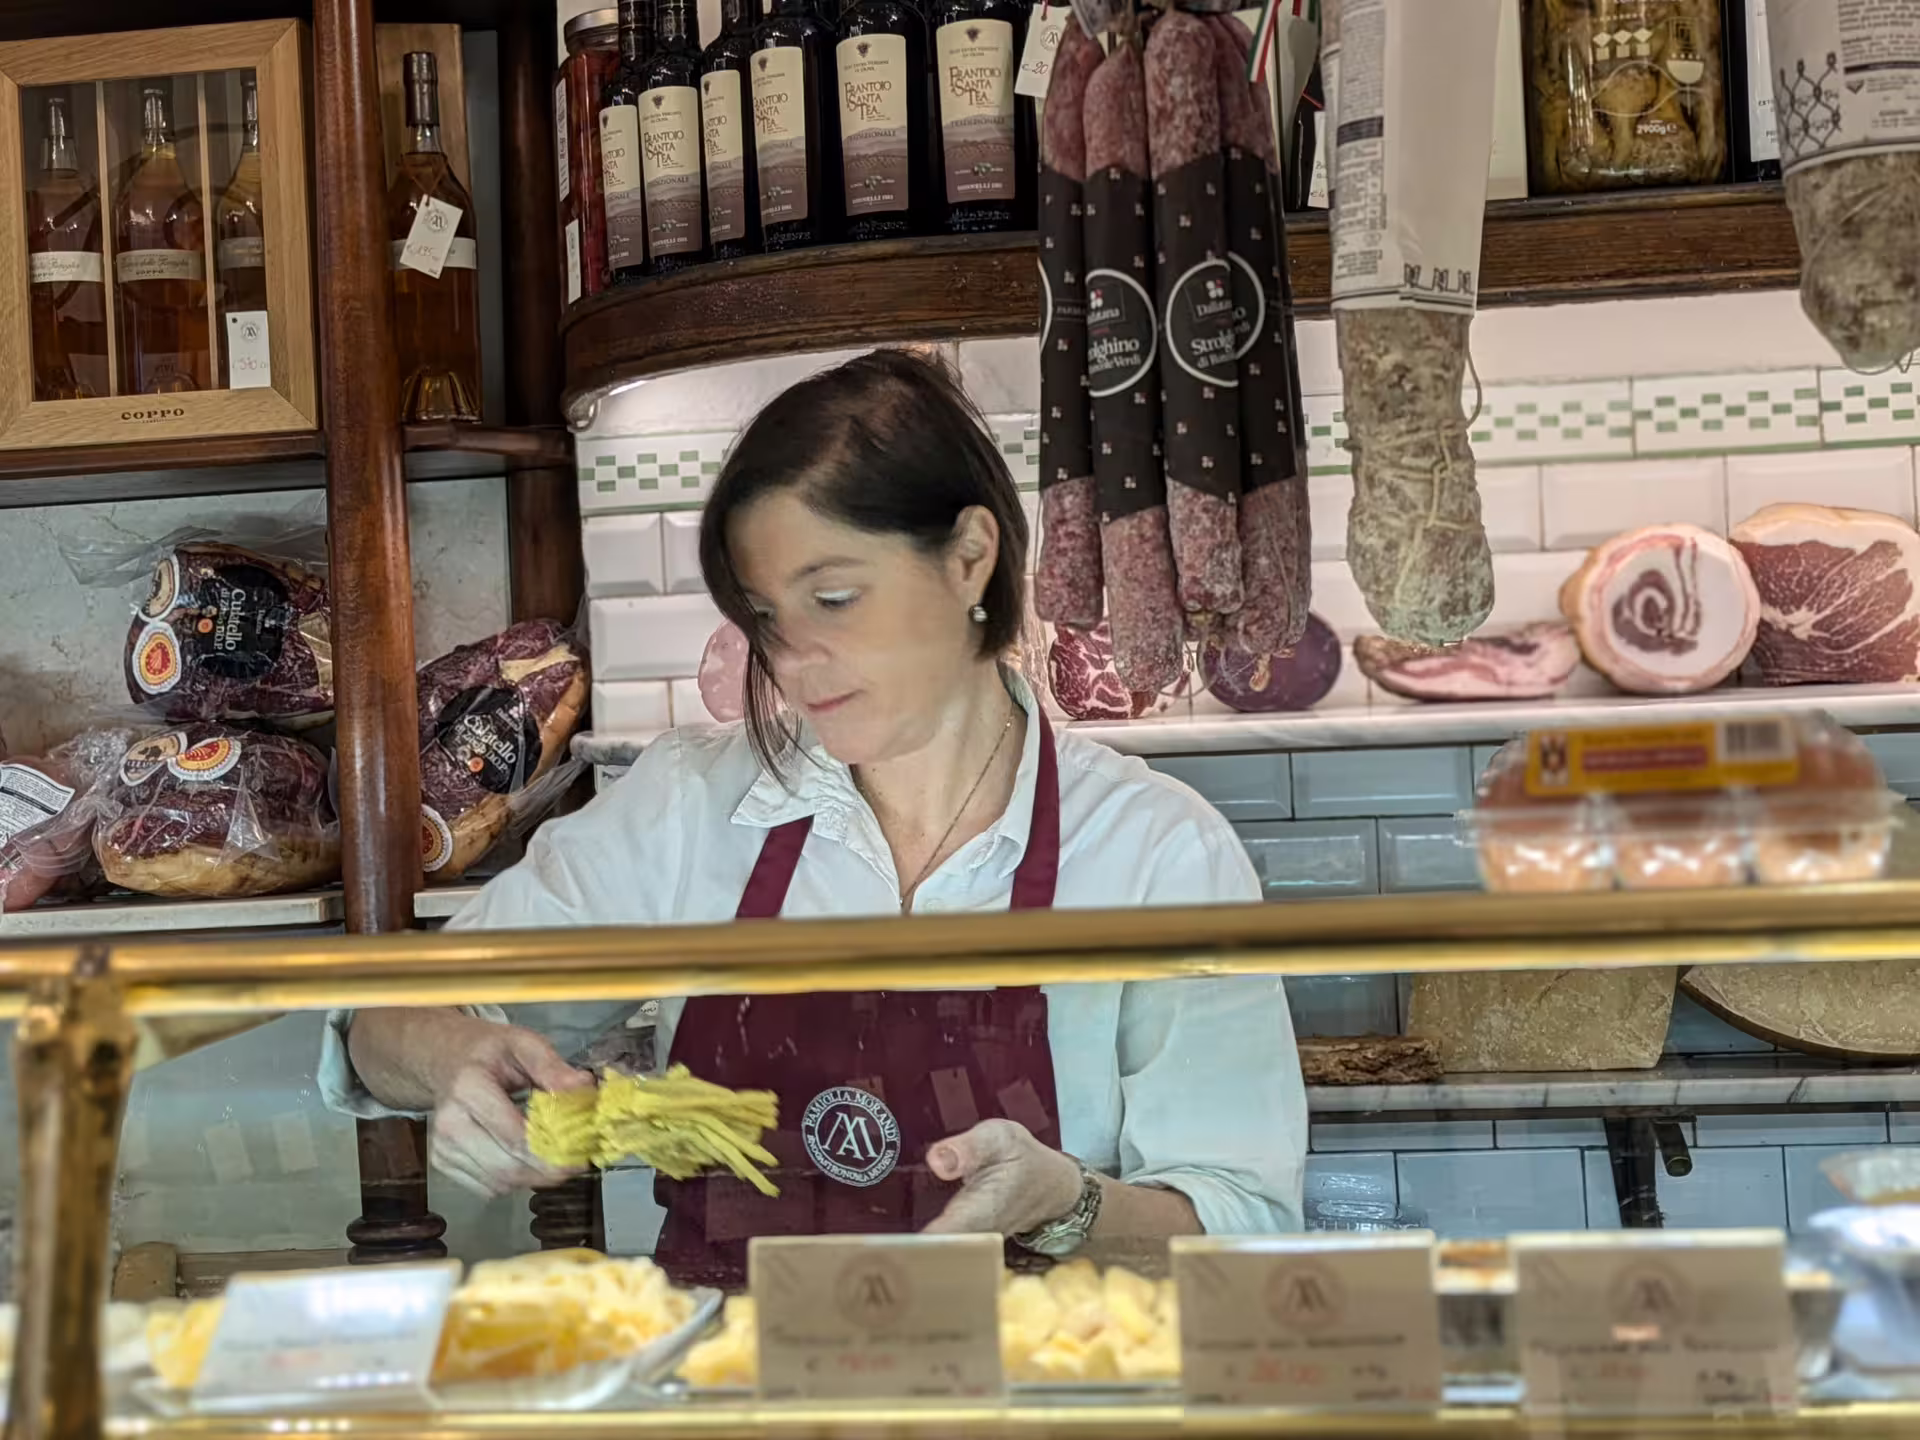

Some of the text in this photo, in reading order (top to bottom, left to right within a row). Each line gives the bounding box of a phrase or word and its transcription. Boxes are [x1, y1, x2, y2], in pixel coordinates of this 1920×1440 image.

[949, 66, 1001, 87] FRANTOIO
[844, 81, 892, 103] FRANTOIO
[951, 79, 993, 97] SANTA
[847, 93, 883, 112] SANTA
[643, 130, 685, 149] FRANTOIO
[646, 142, 676, 161] SANTA
[121, 408, 185, 421] COPPO
[224, 588, 246, 651] Culatello
[463, 713, 517, 764] Culatello
[803, 1090, 852, 1128] FAMIGLIA
[854, 1092, 898, 1142] MORANDI
